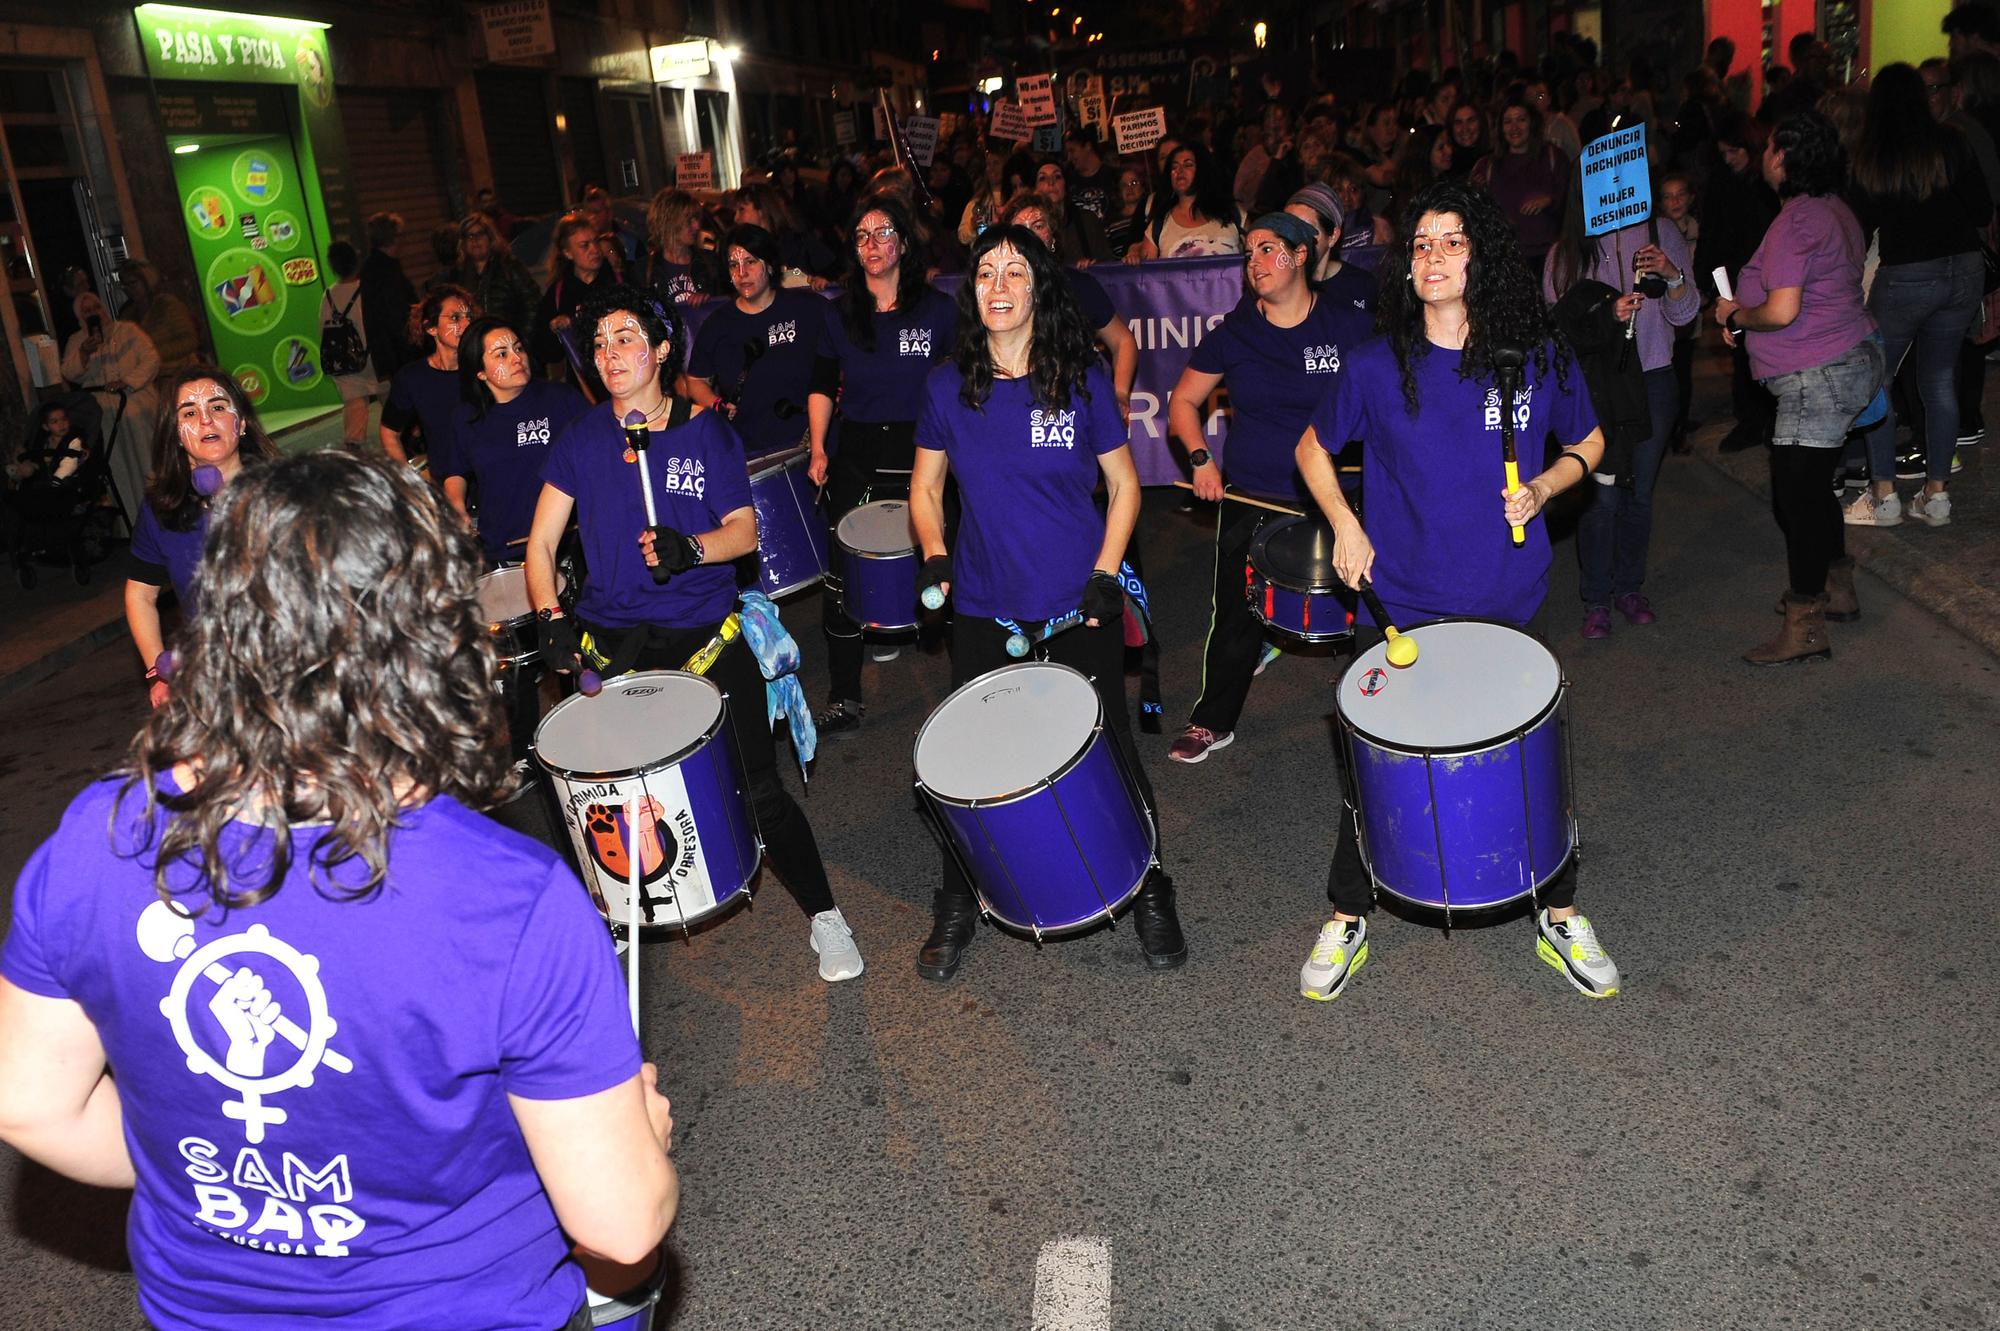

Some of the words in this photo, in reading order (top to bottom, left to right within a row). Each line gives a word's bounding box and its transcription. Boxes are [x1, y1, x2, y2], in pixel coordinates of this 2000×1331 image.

[156, 28, 218, 66] PASA
[217, 34, 236, 65] Y
[236, 36, 287, 70] PICA
[1019, 82, 1029, 91] NO
[1038, 80, 1050, 89] NO
[1120, 111, 1156, 123] Nosotras
[1120, 119, 1158, 132] PARIMOS
[1123, 129, 1160, 141] Nosotras
[1588, 129, 1641, 157] DENUNCIA
[1119, 138, 1161, 151] DECIDIMO
[1585, 146, 1645, 176] ARCHIVADA
[1599, 186, 1635, 207] MUJER
[1591, 201, 1648, 228] ASESINADA
[768, 320, 796, 335] SAM
[899, 328, 932, 342] SAM
[900, 340, 931, 358] BAQ
[1303, 344, 1339, 359] SAM
[1305, 356, 1341, 374] BAQ
[517, 417, 549, 433] SAM
[1030, 409, 1076, 426] SAM
[517, 428, 550, 445] BAQ
[1031, 425, 1075, 450] BAQ
[666, 473, 706, 501] BAQ
[675, 808, 698, 878] OPRESORA
[177, 1136, 354, 1204] SAM
[193, 1183, 367, 1258] BAQ
